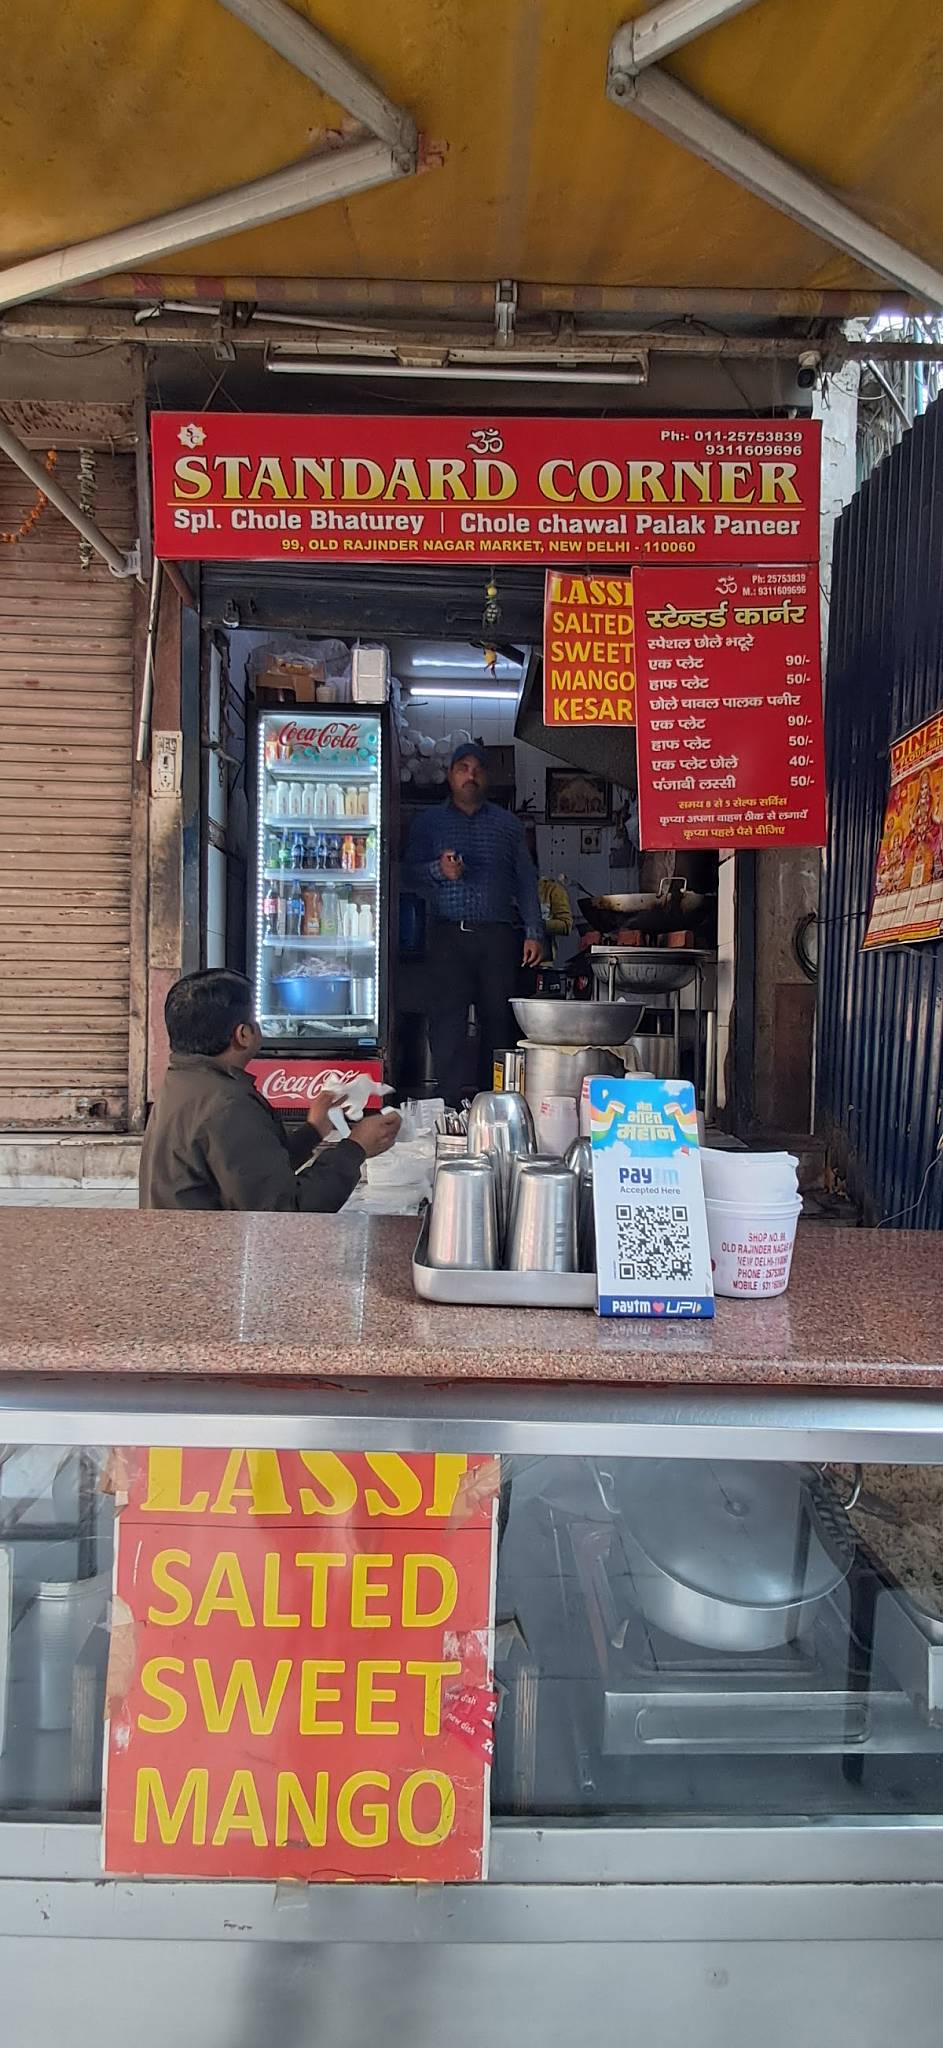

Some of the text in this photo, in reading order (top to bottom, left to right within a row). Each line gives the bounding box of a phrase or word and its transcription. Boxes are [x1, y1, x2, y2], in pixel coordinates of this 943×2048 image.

[660, 430, 802, 442] Ph:- 011-25753839
[705, 444, 802, 456] 9311609696
[173, 455, 802, 504] STANDARD CORNER
[174, 508, 801, 536] Spl. Chole Bhaturey Chole chawal Palak Paneer
[281, 539, 304, 552] 99,
[309, 540, 338, 551] OLD
[343, 540, 418, 551] RAJINDER
[423, 540, 475, 552] NAGAR
[480, 540, 545, 553] MARKET,
[549, 541, 582, 552] NEW
[586, 541, 630, 552] DELHI
[643, 541, 695, 552] 110060
[752, 573, 805, 584] Ph: 25753839
[550, 577, 633, 606] LASSI
[758, 586, 807, 596] 9311609696
[734, 599, 807, 625] कार्नर
[553, 611, 634, 635] SALTED
[647, 633, 754, 652] स्पेशल छोले भटूरे
[551, 641, 634, 664] SWEET
[648, 655, 810, 670] एक प्लेट 90/-
[551, 670, 636, 691] MANGO
[649, 673, 811, 691] हाफ प्लेट 50/-
[553, 697, 633, 721] KESAR
[649, 692, 801, 710] छोले चावल पालक पनीर
[650, 715, 813, 731] एक प्लेट 90/-
[278, 721, 361, 751] Coca-Cola
[650, 735, 813, 751] हाफ प्लेट 50/-
[651, 755, 814, 771] एक प्लेट छोले 40/-
[652, 775, 815, 791] पंजाबी लस्सी 50/-
[767, 810, 776, 820] से
[620, 1186, 681, 1195] Accepted Here
[748, 1232, 767, 1242] SHOP
[722, 1242, 736, 1253] OLD
[738, 1244, 771, 1254] RAJINDER
[738, 1269, 761, 1279] PHONE
[733, 1280, 758, 1291] MOBILE
[666, 1301, 697, 1313] UPI
[148, 1548, 459, 1629] SALTED
[137, 1656, 462, 1736] SWEET
[460, 1694, 477, 1705] dish
[446, 1713, 476, 1736] new dish
[134, 1766, 456, 1848] MANGO
